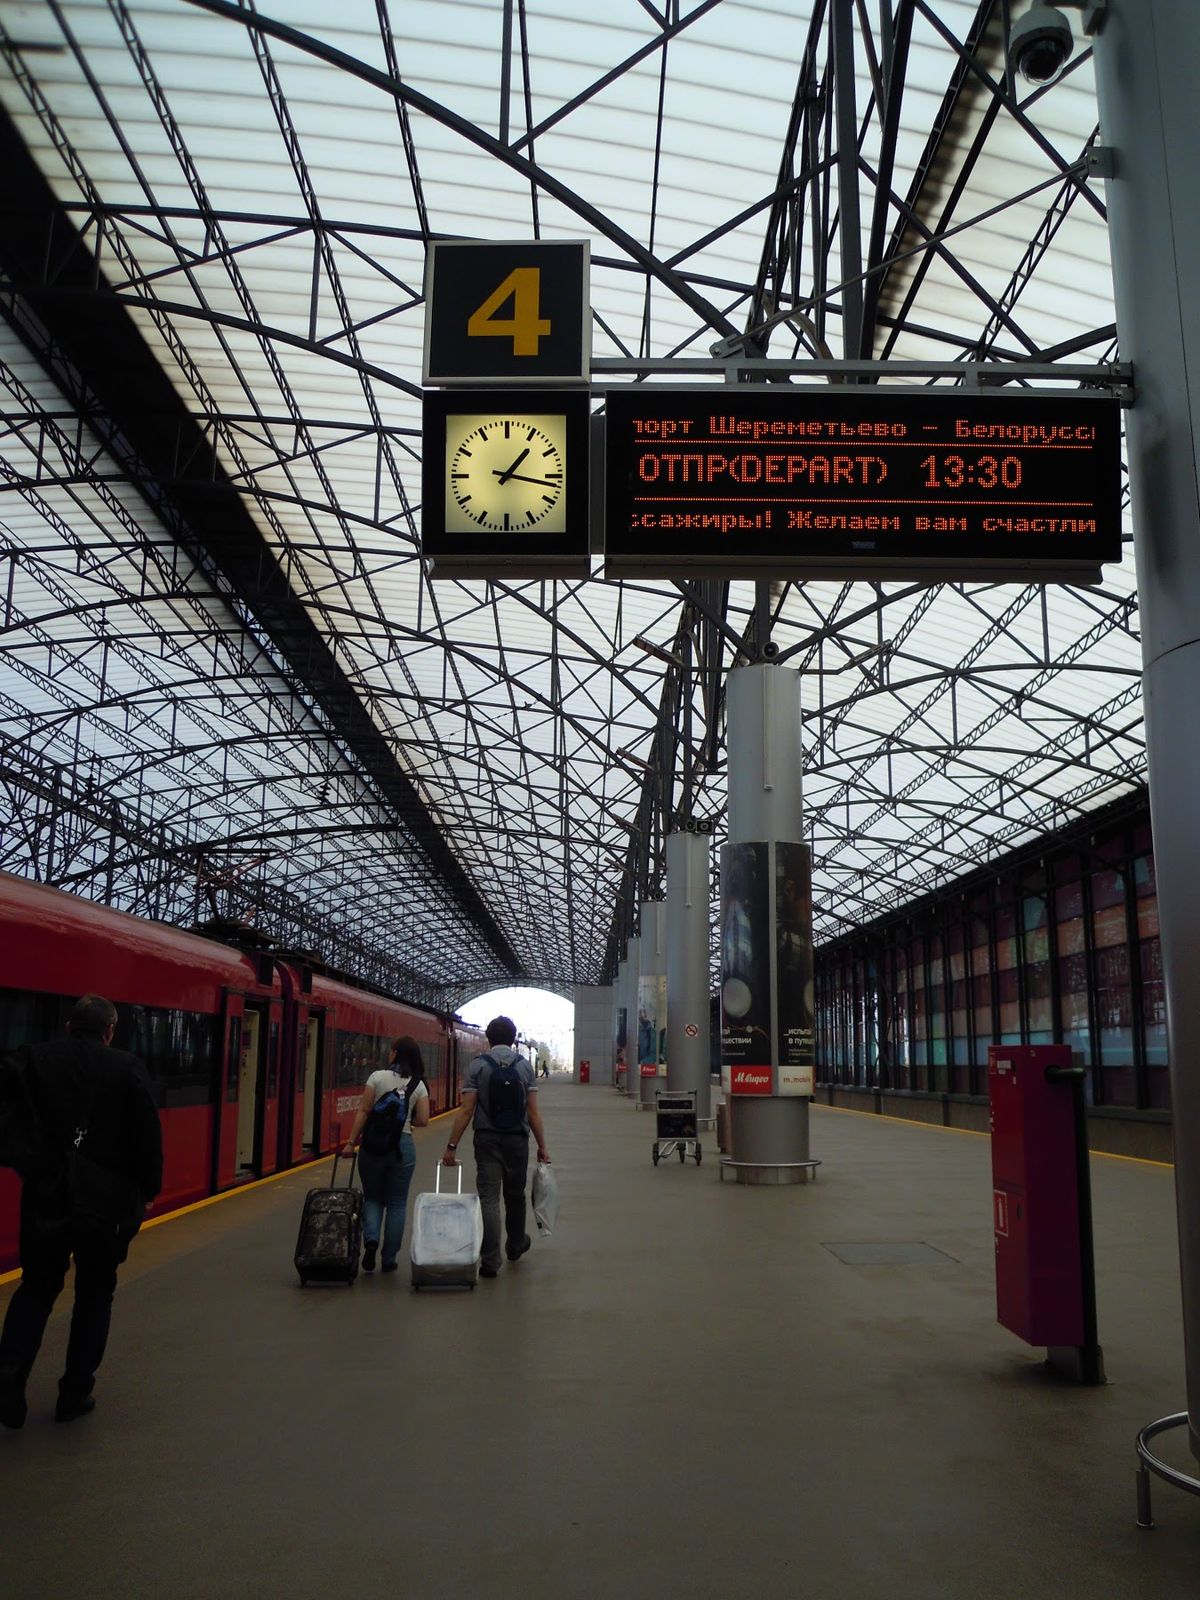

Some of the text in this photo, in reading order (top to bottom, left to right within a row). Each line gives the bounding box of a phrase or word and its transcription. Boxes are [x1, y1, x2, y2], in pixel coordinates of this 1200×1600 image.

[467, 267, 551, 356] 4
[711, 416, 908, 440] Шереметьево
[956, 419, 1095, 444] Белорусс
[920, 455, 1022, 489] 13:30
[788, 510, 900, 531] Желаем
[916, 517, 967, 531] вам
[983, 518, 1096, 533] счастли
